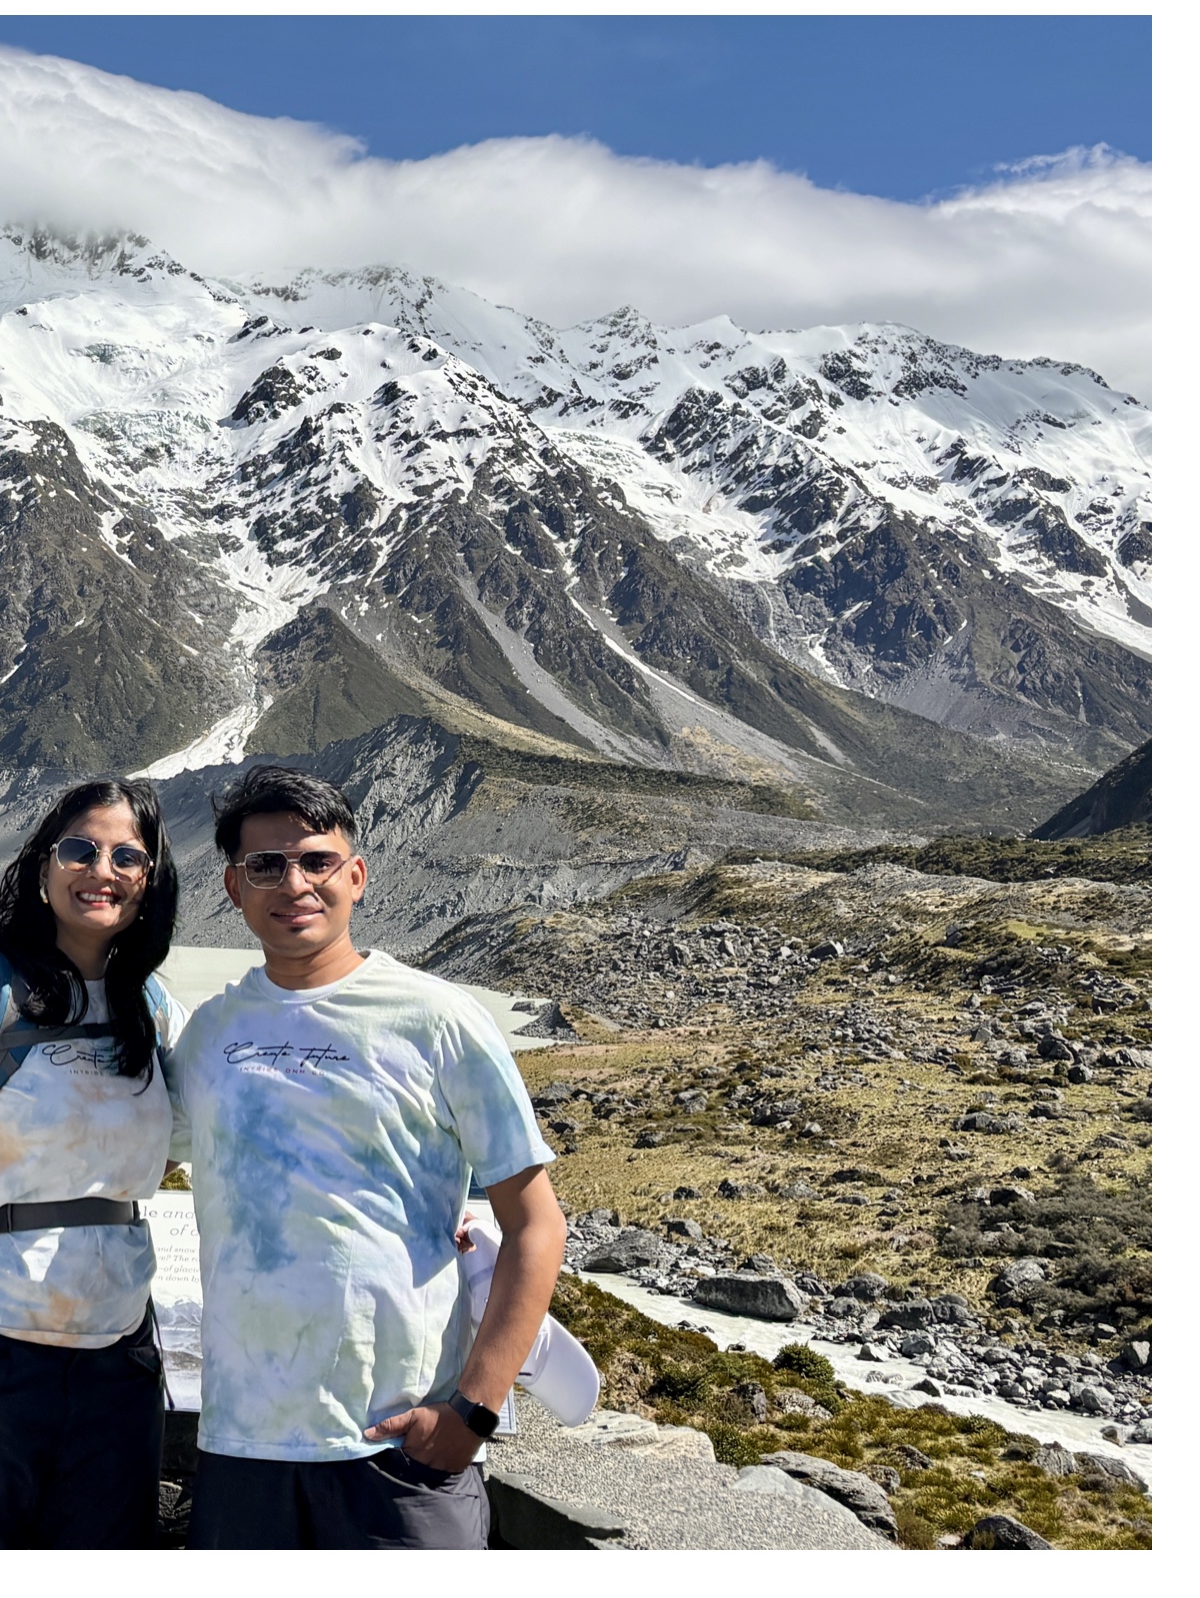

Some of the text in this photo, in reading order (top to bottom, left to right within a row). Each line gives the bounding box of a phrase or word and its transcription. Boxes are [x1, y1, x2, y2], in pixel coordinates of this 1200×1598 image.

[223, 1041, 294, 1065] Create
[143, 1205, 158, 1218] le
[170, 1223, 189, 1236] of
[166, 1274, 189, 1282] down
